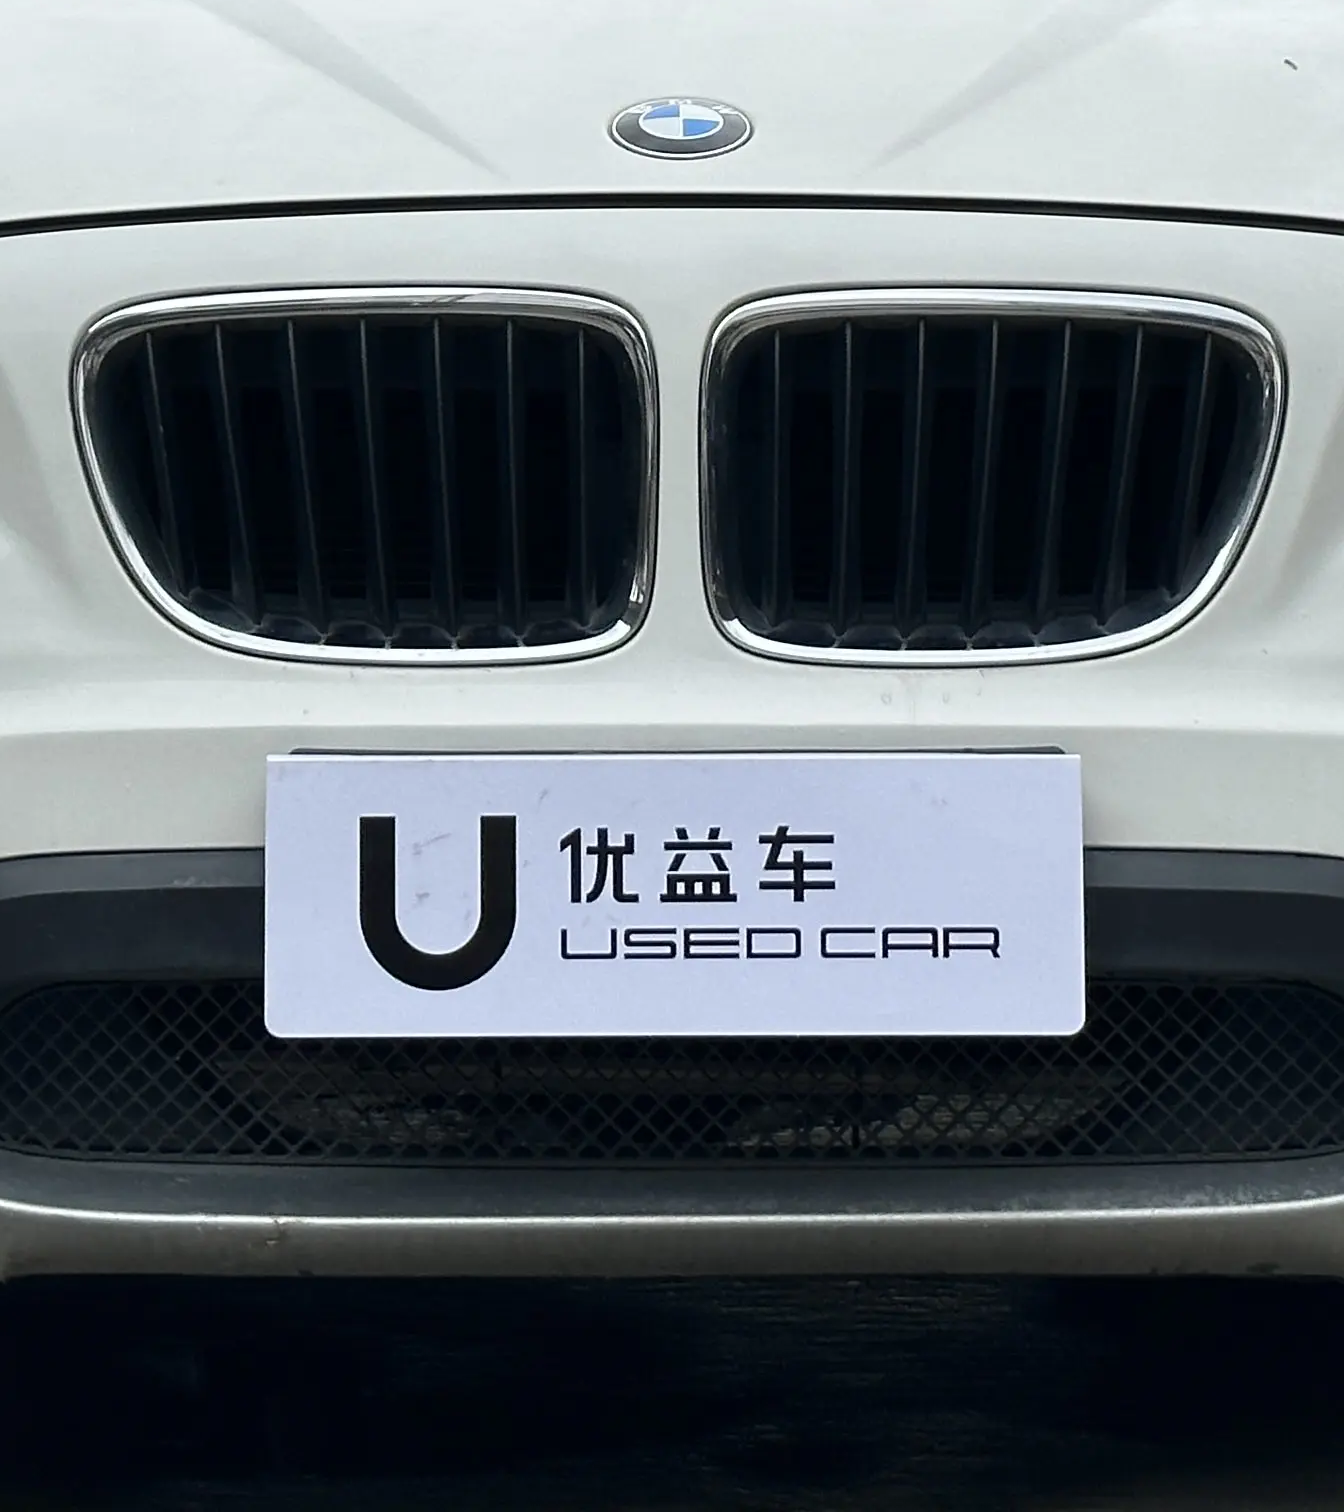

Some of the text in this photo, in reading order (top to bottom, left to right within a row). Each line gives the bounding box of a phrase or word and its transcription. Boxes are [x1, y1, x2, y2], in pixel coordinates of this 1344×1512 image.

[359, 815, 517, 991] U
[559, 825, 836, 903] 优益车
[560, 926, 1001, 960] USED CAR
